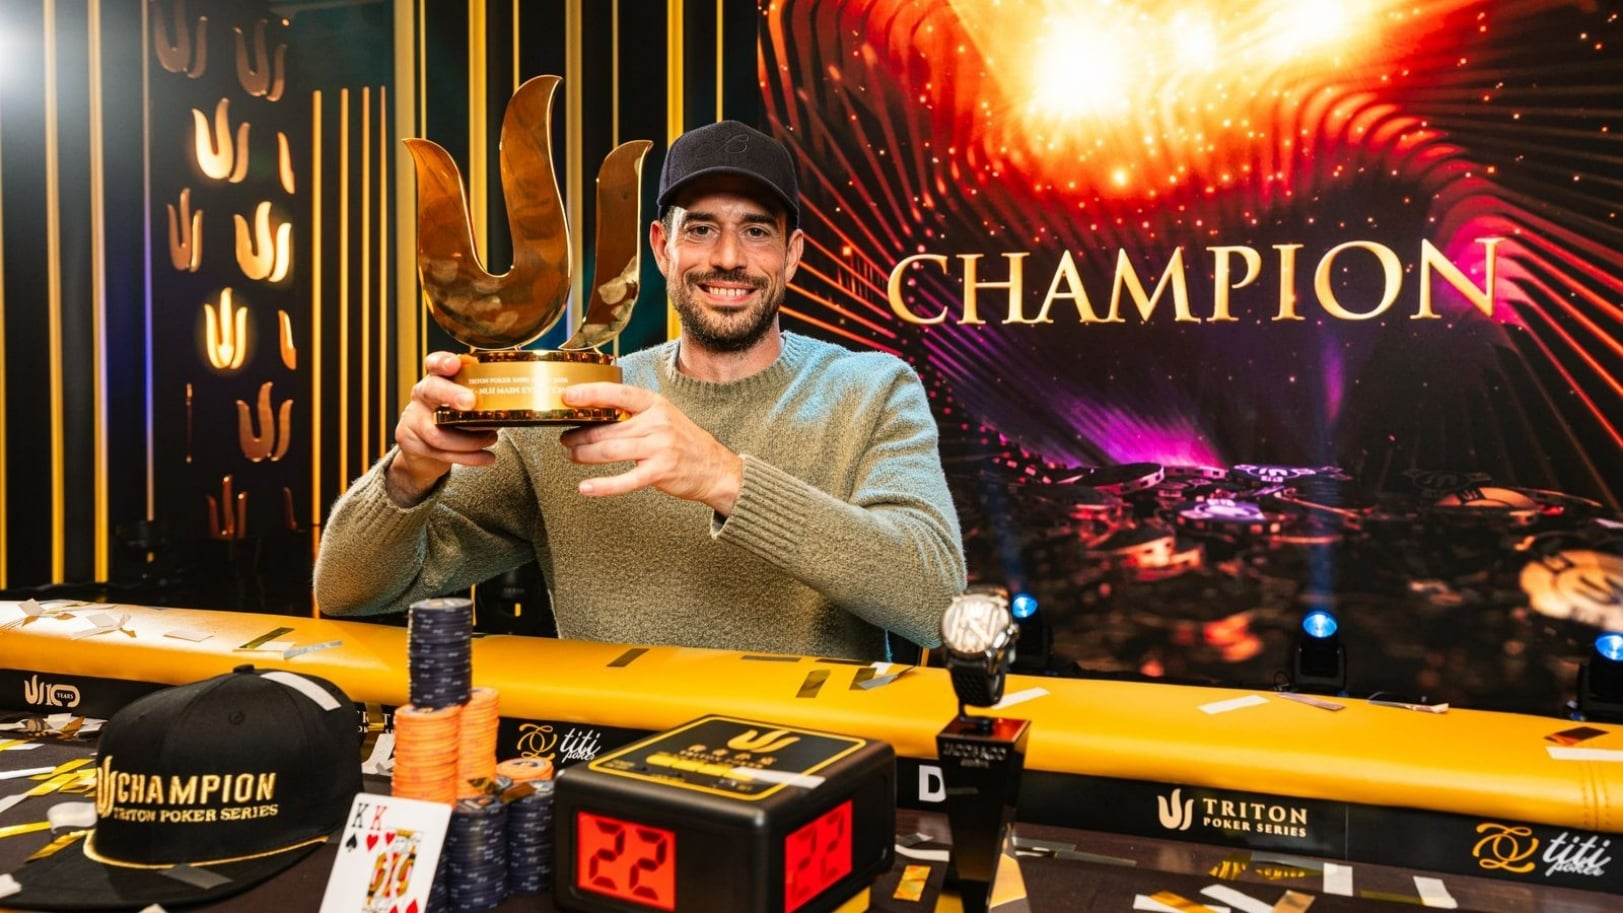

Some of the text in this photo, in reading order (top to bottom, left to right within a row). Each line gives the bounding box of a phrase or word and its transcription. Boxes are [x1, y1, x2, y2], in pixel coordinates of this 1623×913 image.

[886, 237, 1506, 326] CHAMPION
[56, 692, 74, 700] YEARS
[560, 727, 601, 754] titi
[117, 772, 277, 805] CHAMPION
[113, 804, 279, 823] TRITON POKER SERIES
[351, 802, 369, 828] K
[369, 804, 388, 831] K
[1203, 797, 1308, 825] TRITON
[1203, 817, 1307, 837] POKER SERIES
[589, 818, 668, 902] 22
[1542, 831, 1612, 865] titi
